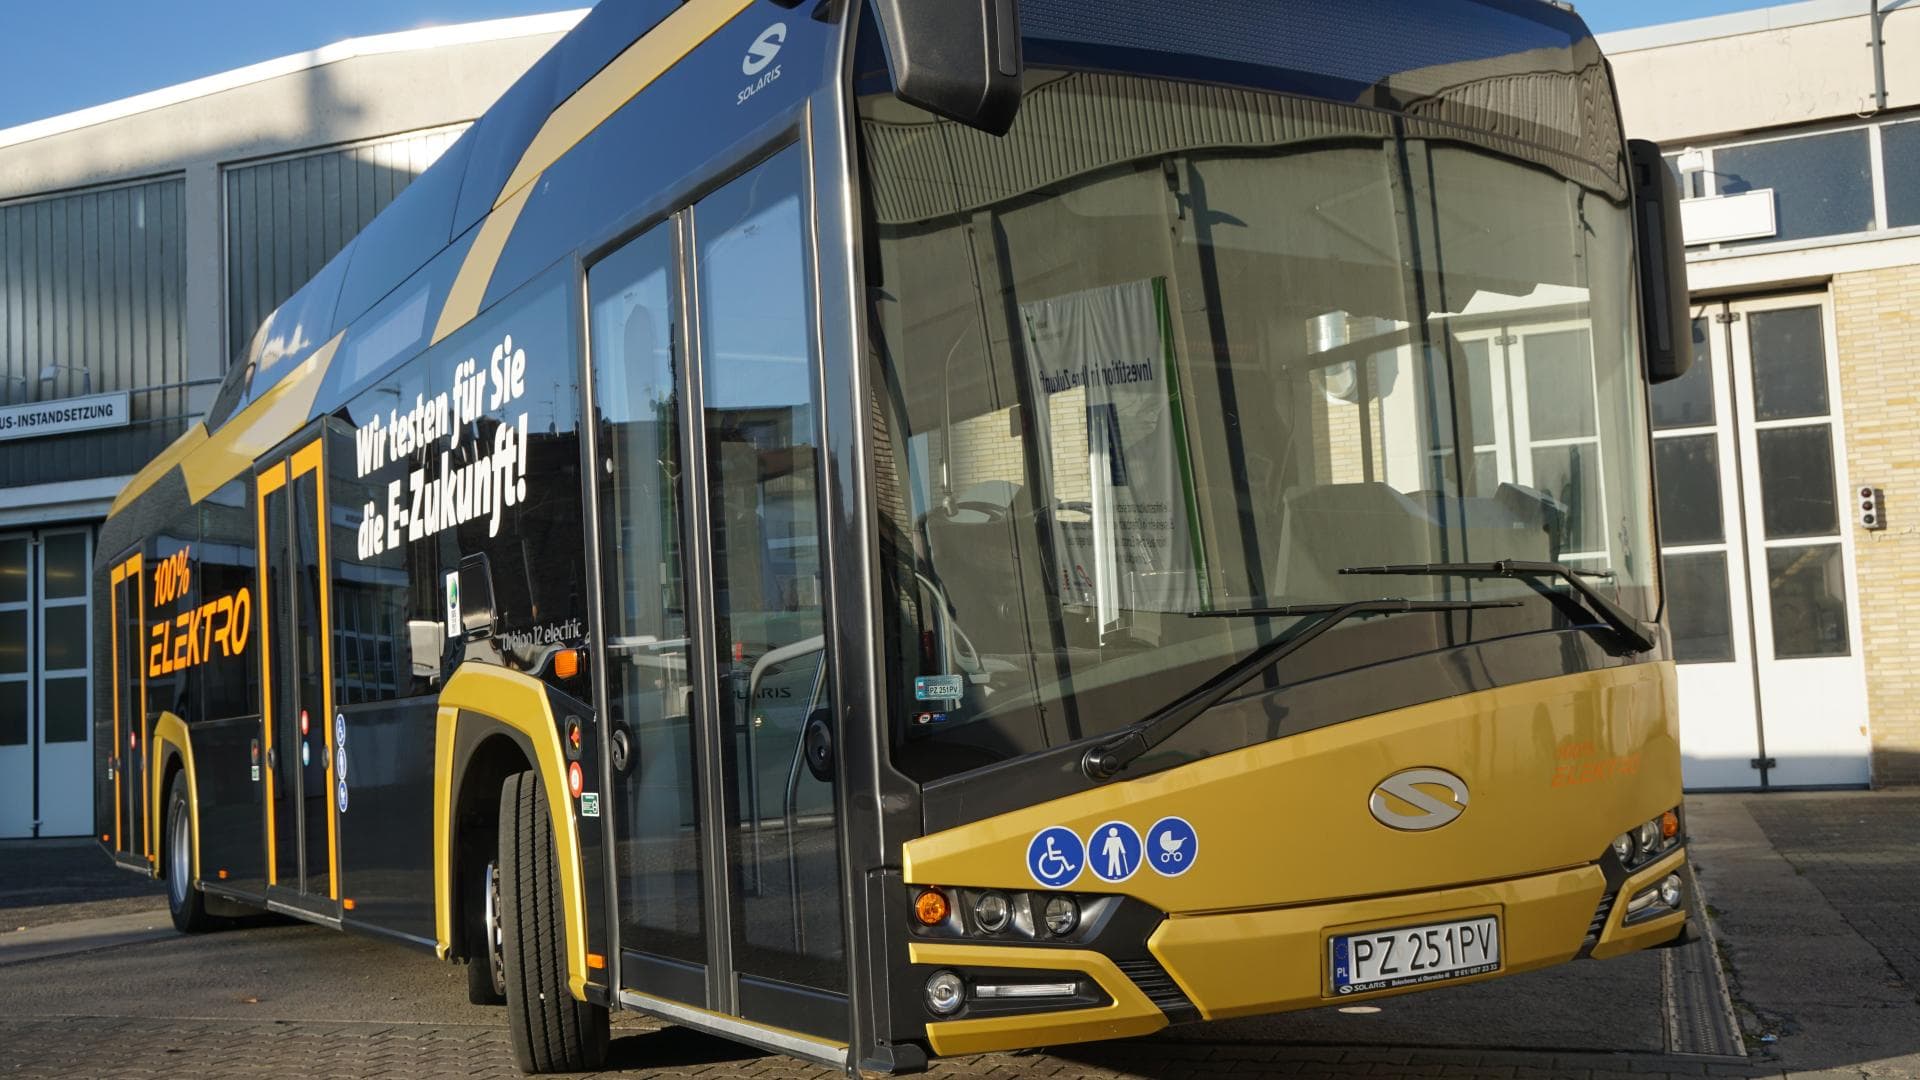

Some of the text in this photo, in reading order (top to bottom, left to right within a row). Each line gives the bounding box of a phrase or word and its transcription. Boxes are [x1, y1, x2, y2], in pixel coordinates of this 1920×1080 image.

[736, 64, 782, 105] SOLARIS
[356, 334, 526, 478] Wir testen für Sie
[358, 412, 528, 560] die E-Zukunft!
[154, 545, 190, 608] 100%
[150, 587, 250, 678] ELEKTRO
[533, 625, 543, 646] 12
[544, 618, 582, 644] electric
[1337, 967, 1348, 978] PL
[1354, 923, 1491, 979] PZ 251PV
[1354, 981, 1386, 992] SOLARIS
